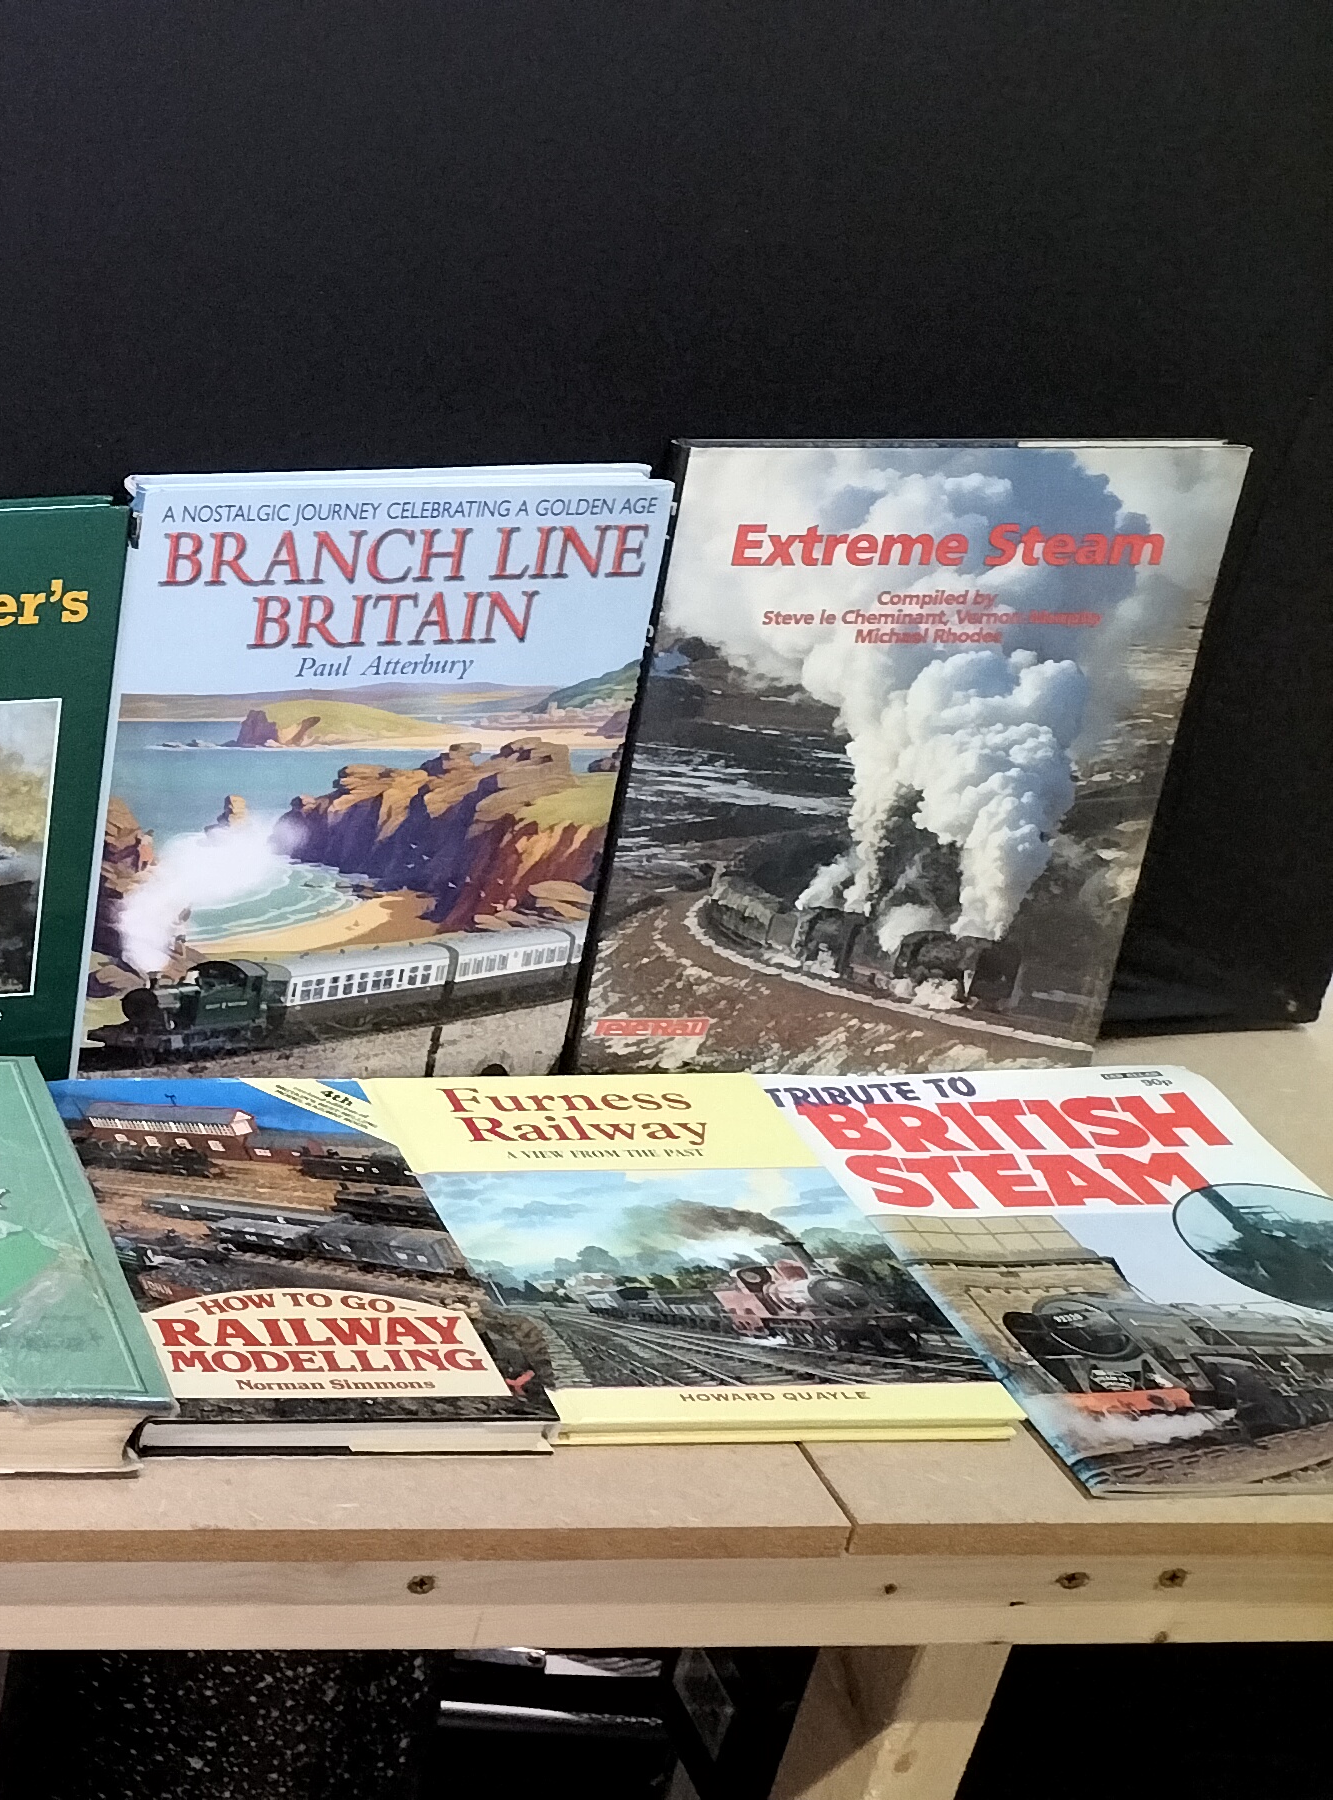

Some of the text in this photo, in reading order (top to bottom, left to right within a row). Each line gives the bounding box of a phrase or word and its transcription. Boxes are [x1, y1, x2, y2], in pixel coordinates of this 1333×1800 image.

[181, 497, 659, 526] NOSTALGIC JOURNEY CELEBRATING GOLDEN AGE
[158, 523, 651, 588] BRANCH LINE
[731, 523, 1166, 566] Extreme Steam
[877, 590, 969, 610] Compiled
[246, 589, 540, 651] BRITAIN
[762, 610, 814, 626] Steve
[819, 609, 837, 625] le
[841, 609, 949, 627] Cheminant,
[854, 629, 1003, 644] Michael Rhodes
[294, 654, 475, 680] Paul Atterbury
[436, 1088, 693, 1113] Furness
[763, 1076, 977, 1109] TRIBUTE TO
[455, 1115, 707, 1146] Railway
[795, 1091, 1234, 1153] BRITISH
[522, 1149, 705, 1159] VIEW FROM THE PAST
[844, 1151, 1213, 1210] STEAM
[197, 1292, 396, 1316] HOW TO GO
[152, 1315, 465, 1348] RAILWAY
[168, 1348, 489, 1373] MODELLING
[235, 1378, 435, 1392] Norman Simmons
[680, 1390, 870, 1402] HOWARD QUAYLE
